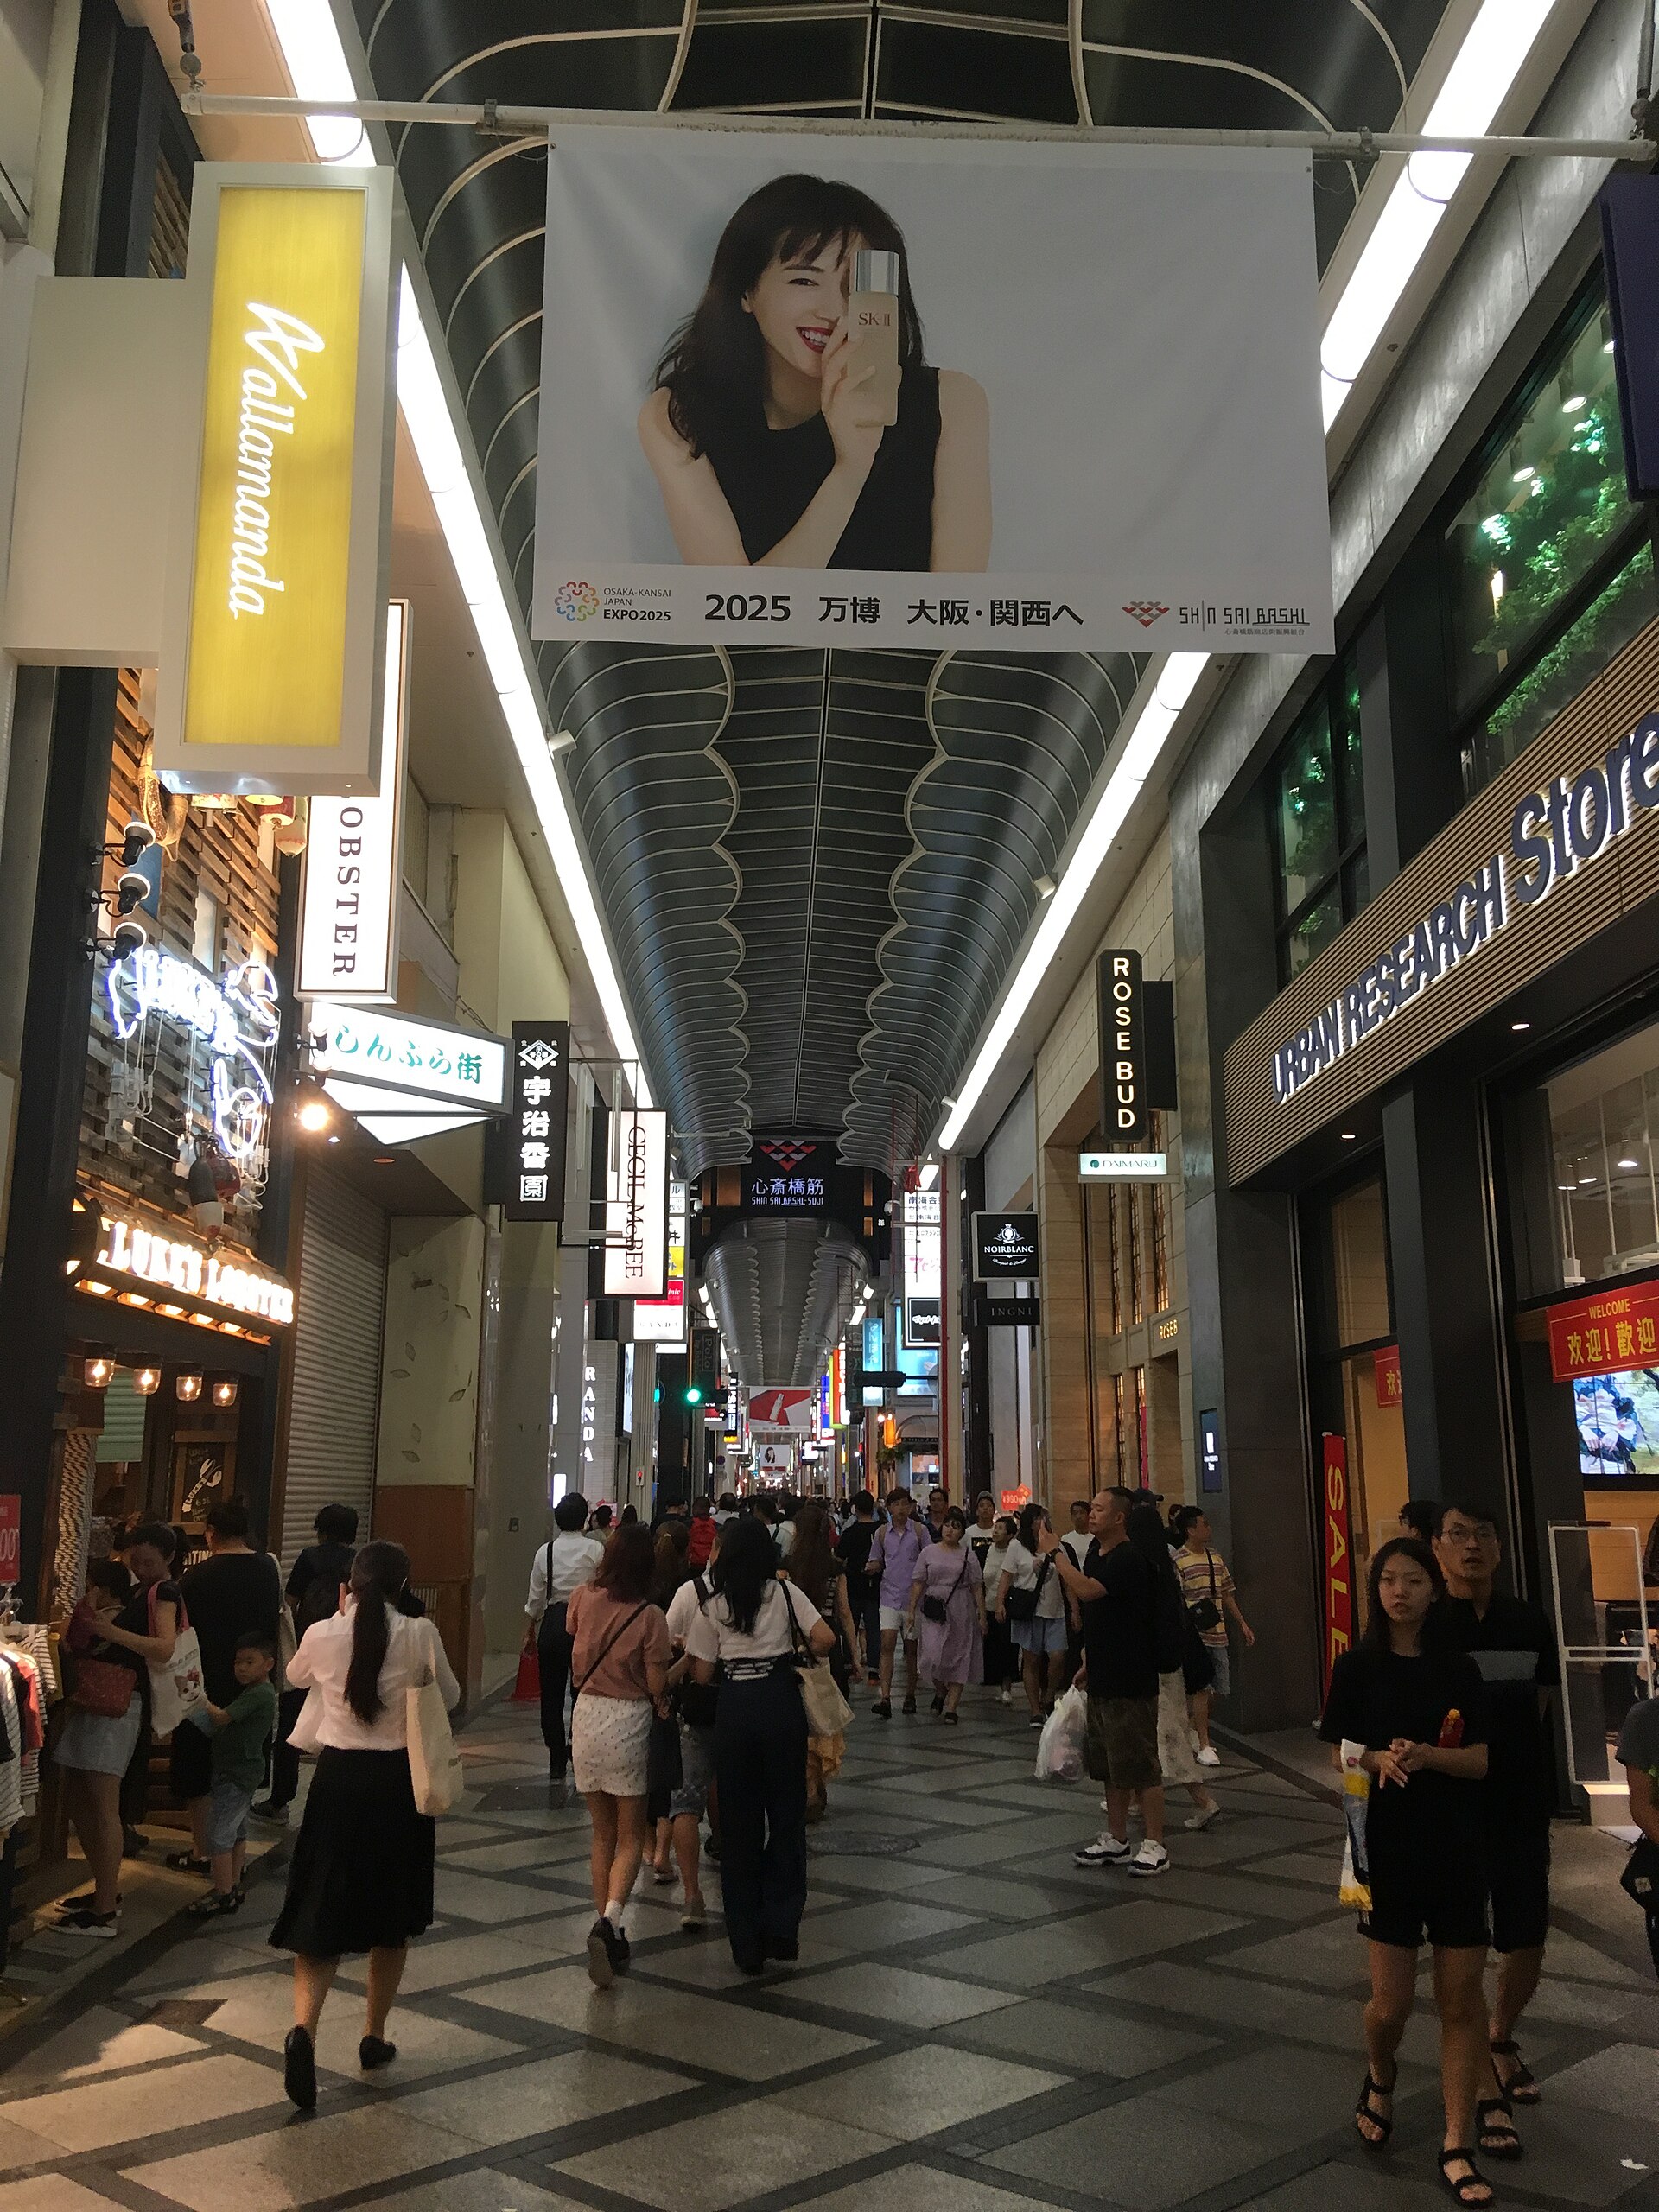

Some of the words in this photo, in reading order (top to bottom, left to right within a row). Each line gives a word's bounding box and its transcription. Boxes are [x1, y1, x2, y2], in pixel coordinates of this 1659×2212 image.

[228, 301, 326, 620] Wallamanda
[603, 588, 671, 598] OSAKA-KANSAI
[603, 609, 671, 621] EXPO2025
[704, 594, 791, 622] 2025
[818, 596, 881, 623] 万博
[907, 599, 1084, 626] 大阪・関西へ
[1224, 607, 1249, 624] SAI
[1252, 607, 1311, 626] BASHI
[332, 805, 364, 976] OBSTER
[1271, 998, 1346, 1104] URBAN
[1342, 854, 1508, 1048] RESEARCH
[1511, 711, 1659, 905] Store
[1113, 957, 1132, 1051] ROSE
[1116, 1061, 1135, 1128] BUD
[751, 1177, 823, 1196] 心斎橋筋
[751, 1197, 767, 1205] SHIN
[909, 1196, 940, 1205] 南海会
[984, 1245, 1034, 1254] NOIRBLANC
[991, 1307, 1032, 1316] INGNI
[1588, 1298, 1631, 1320] WELCOME
[582, 1365, 596, 1462] RANDA
